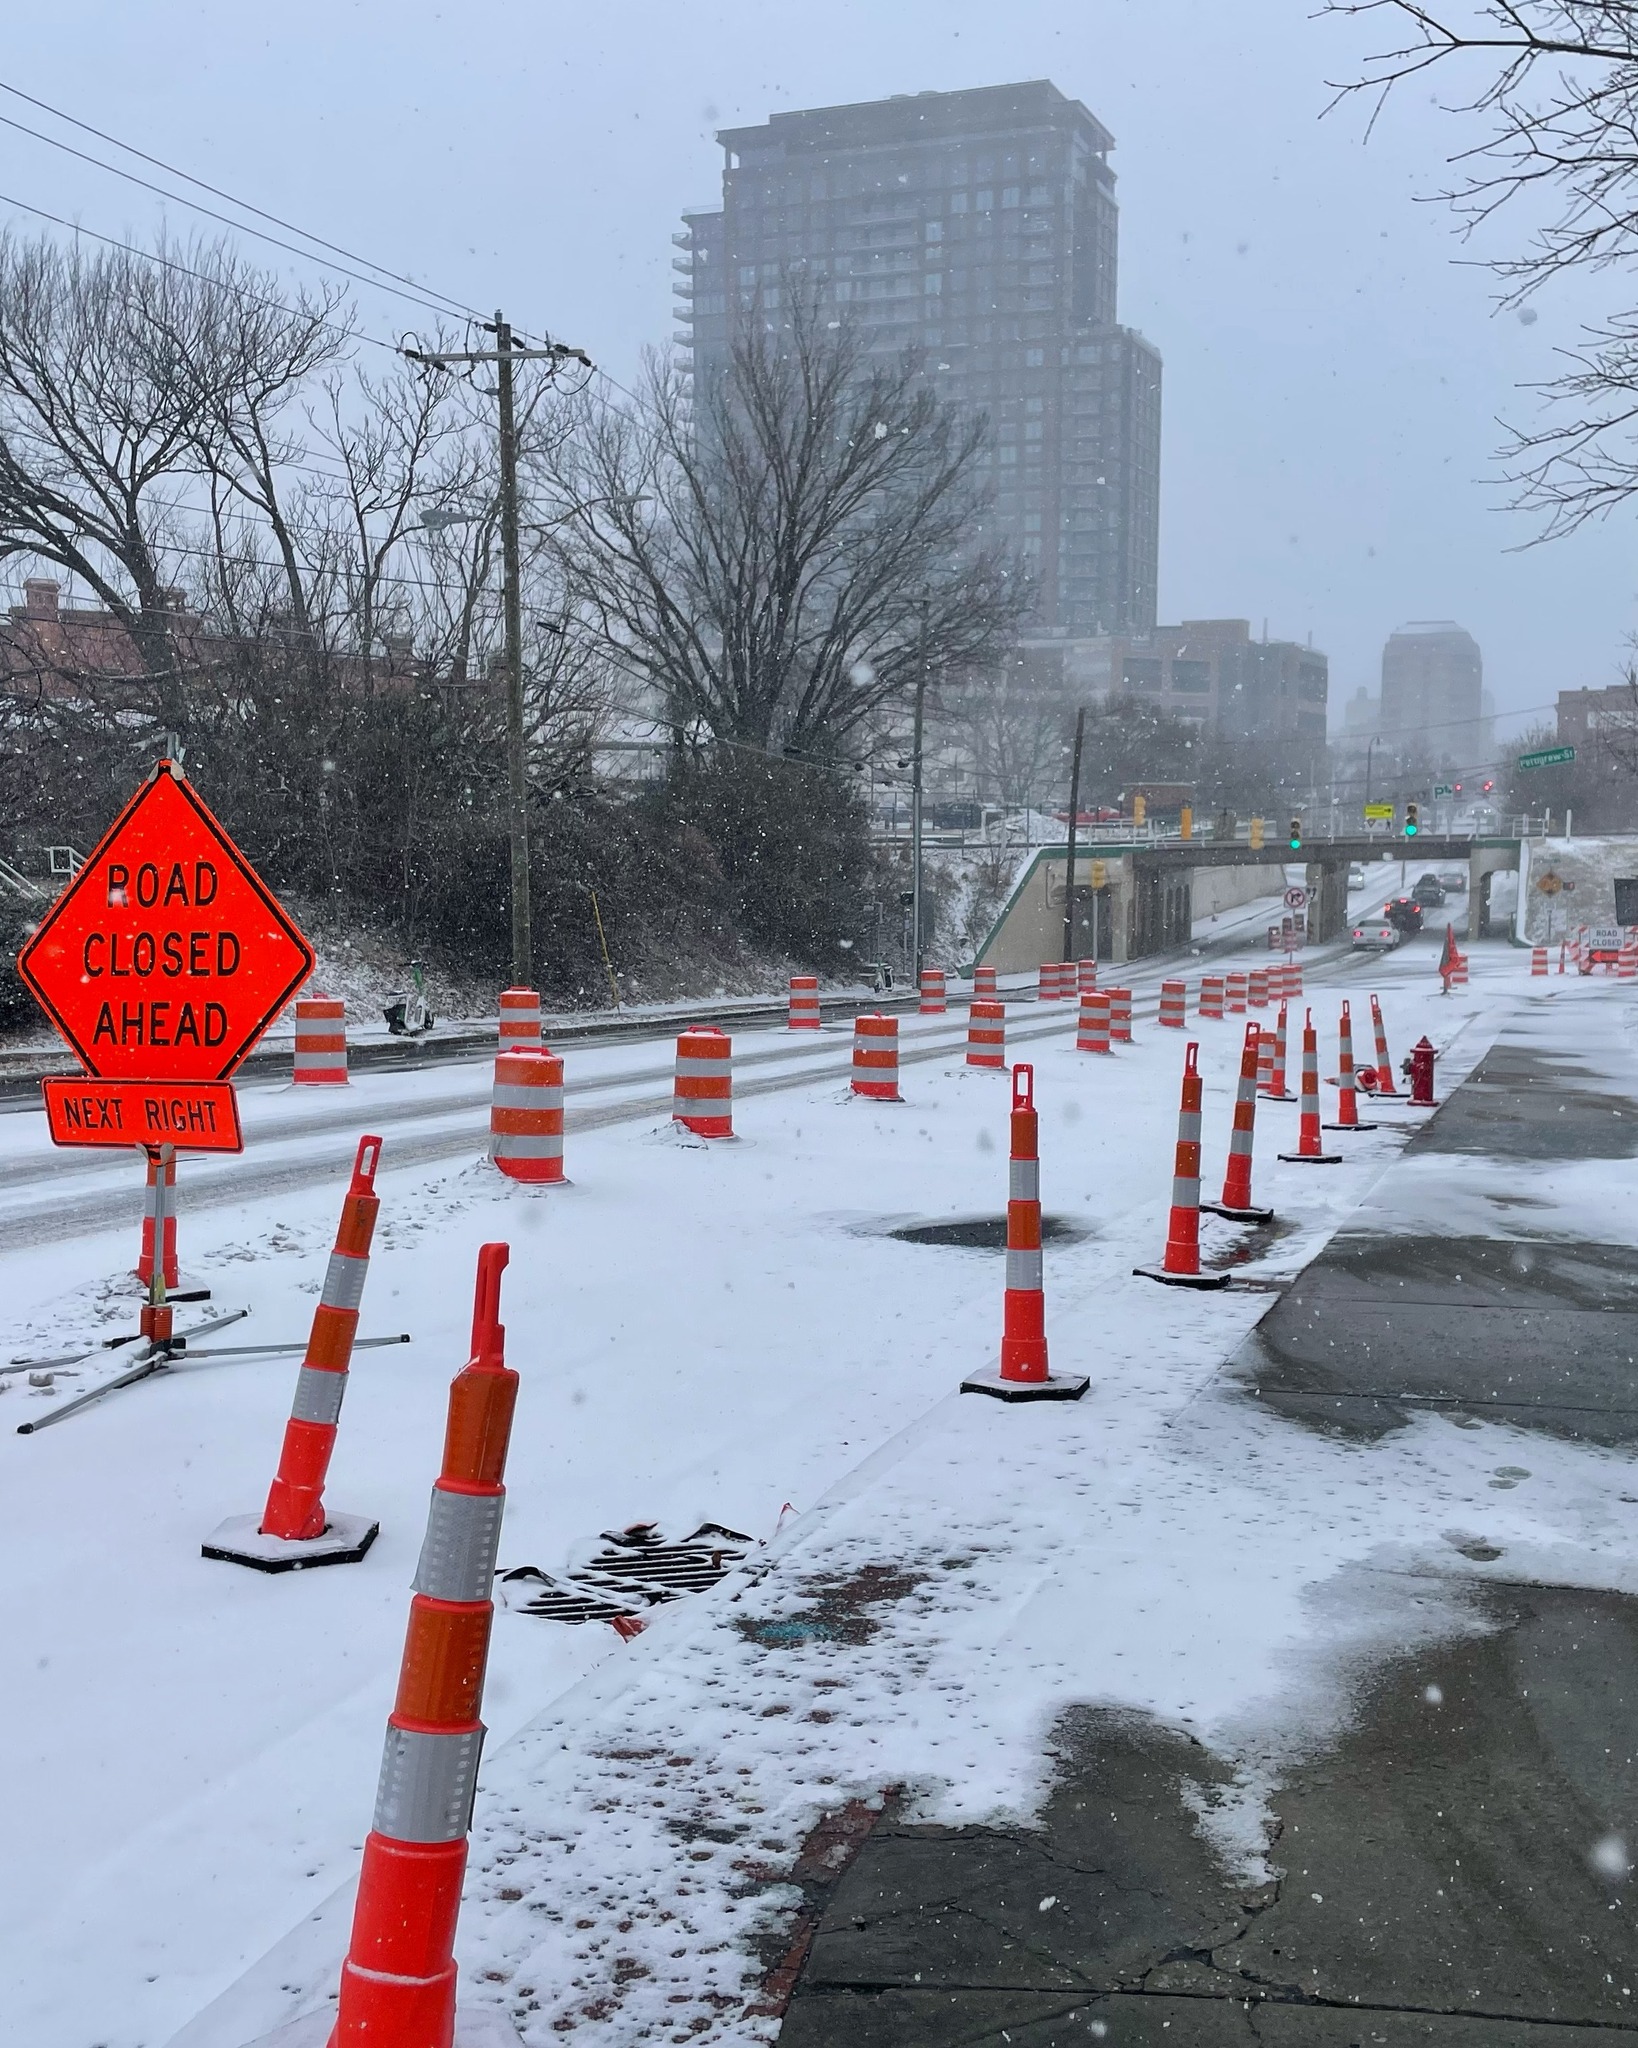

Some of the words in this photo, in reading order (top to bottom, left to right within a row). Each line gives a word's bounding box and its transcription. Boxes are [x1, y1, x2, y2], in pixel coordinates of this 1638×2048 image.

[107, 861, 219, 909] ROAD
[1592, 938, 1622, 947] CLOSED
[1596, 929, 1618, 937] ROAD
[83, 931, 241, 978] CLOSED
[92, 1001, 228, 1048] AHEAD
[63, 1097, 123, 1130] NEXT
[145, 1098, 218, 1134] RIGHT
